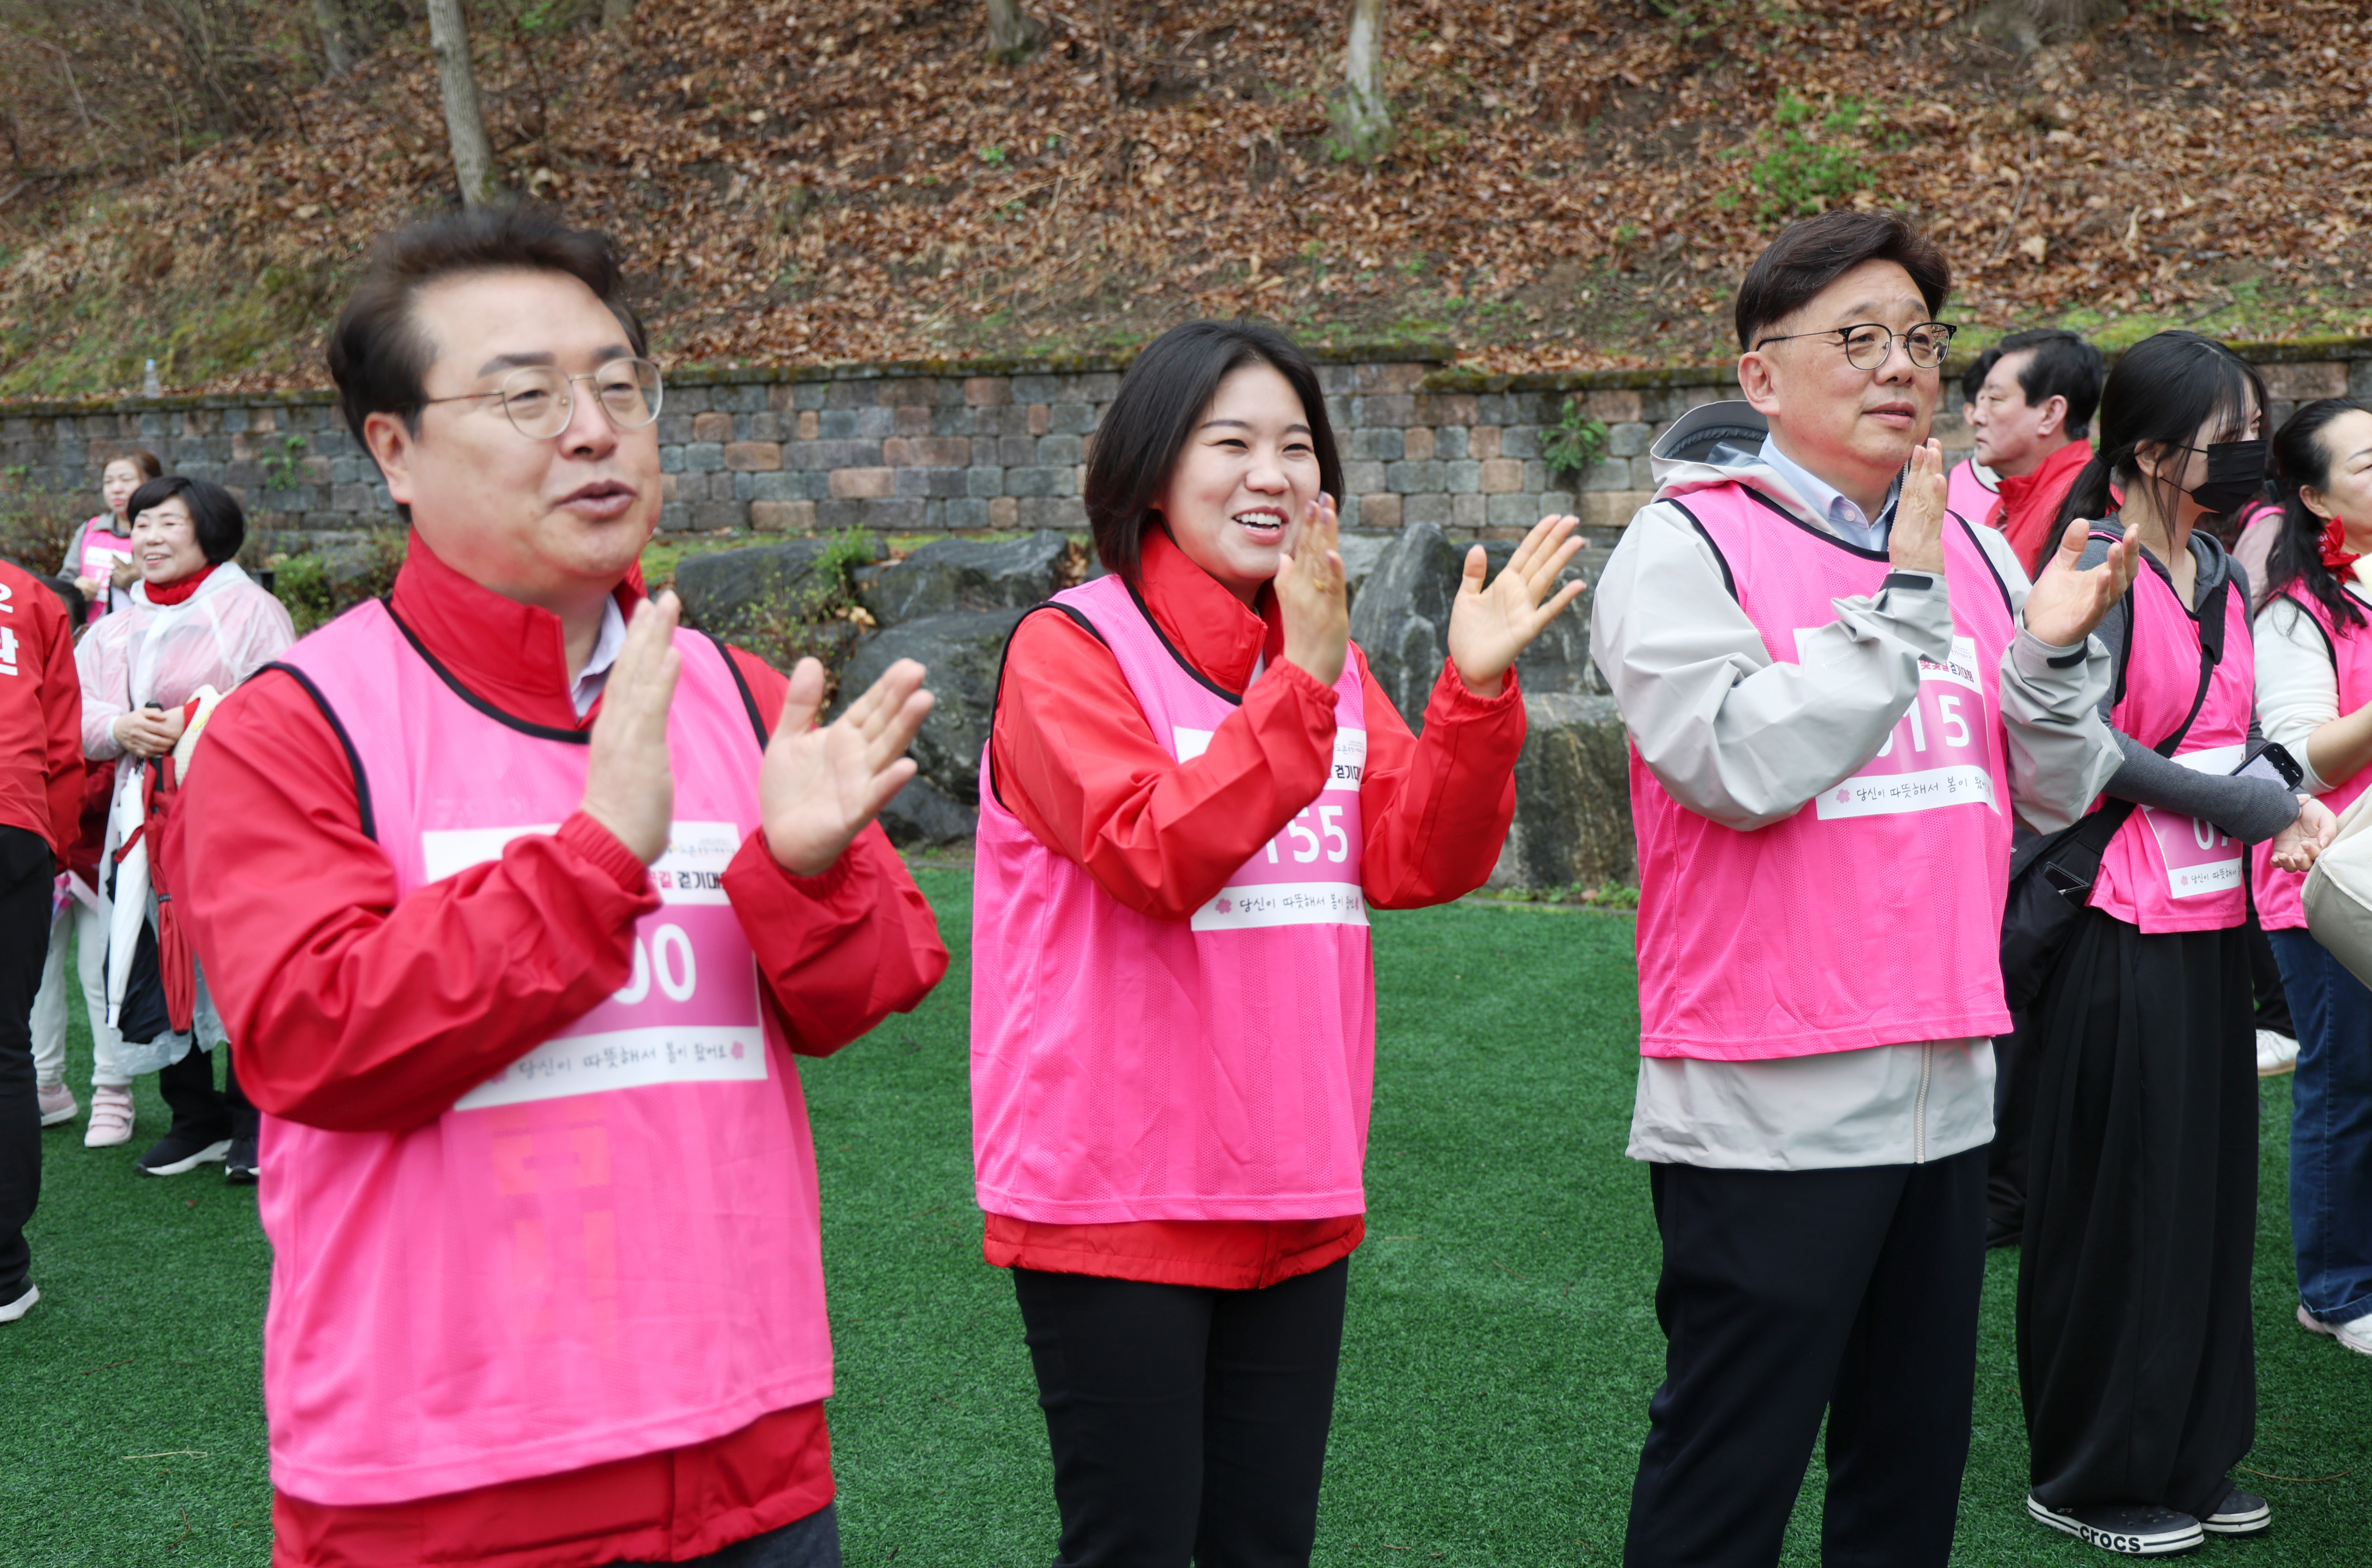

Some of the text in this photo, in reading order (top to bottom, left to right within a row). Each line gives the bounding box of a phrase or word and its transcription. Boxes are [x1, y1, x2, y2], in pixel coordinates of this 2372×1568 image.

[1949, 661, 1975, 683] 걷기대회
[1856, 787, 1885, 801] 당신이
[1890, 782, 1939, 799] 따뜻해서
[1947, 776, 1968, 793] 봄이
[677, 870, 723, 889] 걷기대
[2191, 873, 2209, 884] 당신이
[2213, 868, 2237, 880] 따뜻해서
[1240, 897, 1276, 912] 당신이
[1284, 893, 1325, 909] 따뜻해서
[1331, 892, 1343, 909] 봄이
[519, 1040, 727, 1079] 당신이 따뜻해서 봄이 왔어요
[2080, 1525, 2141, 1552] crocs
